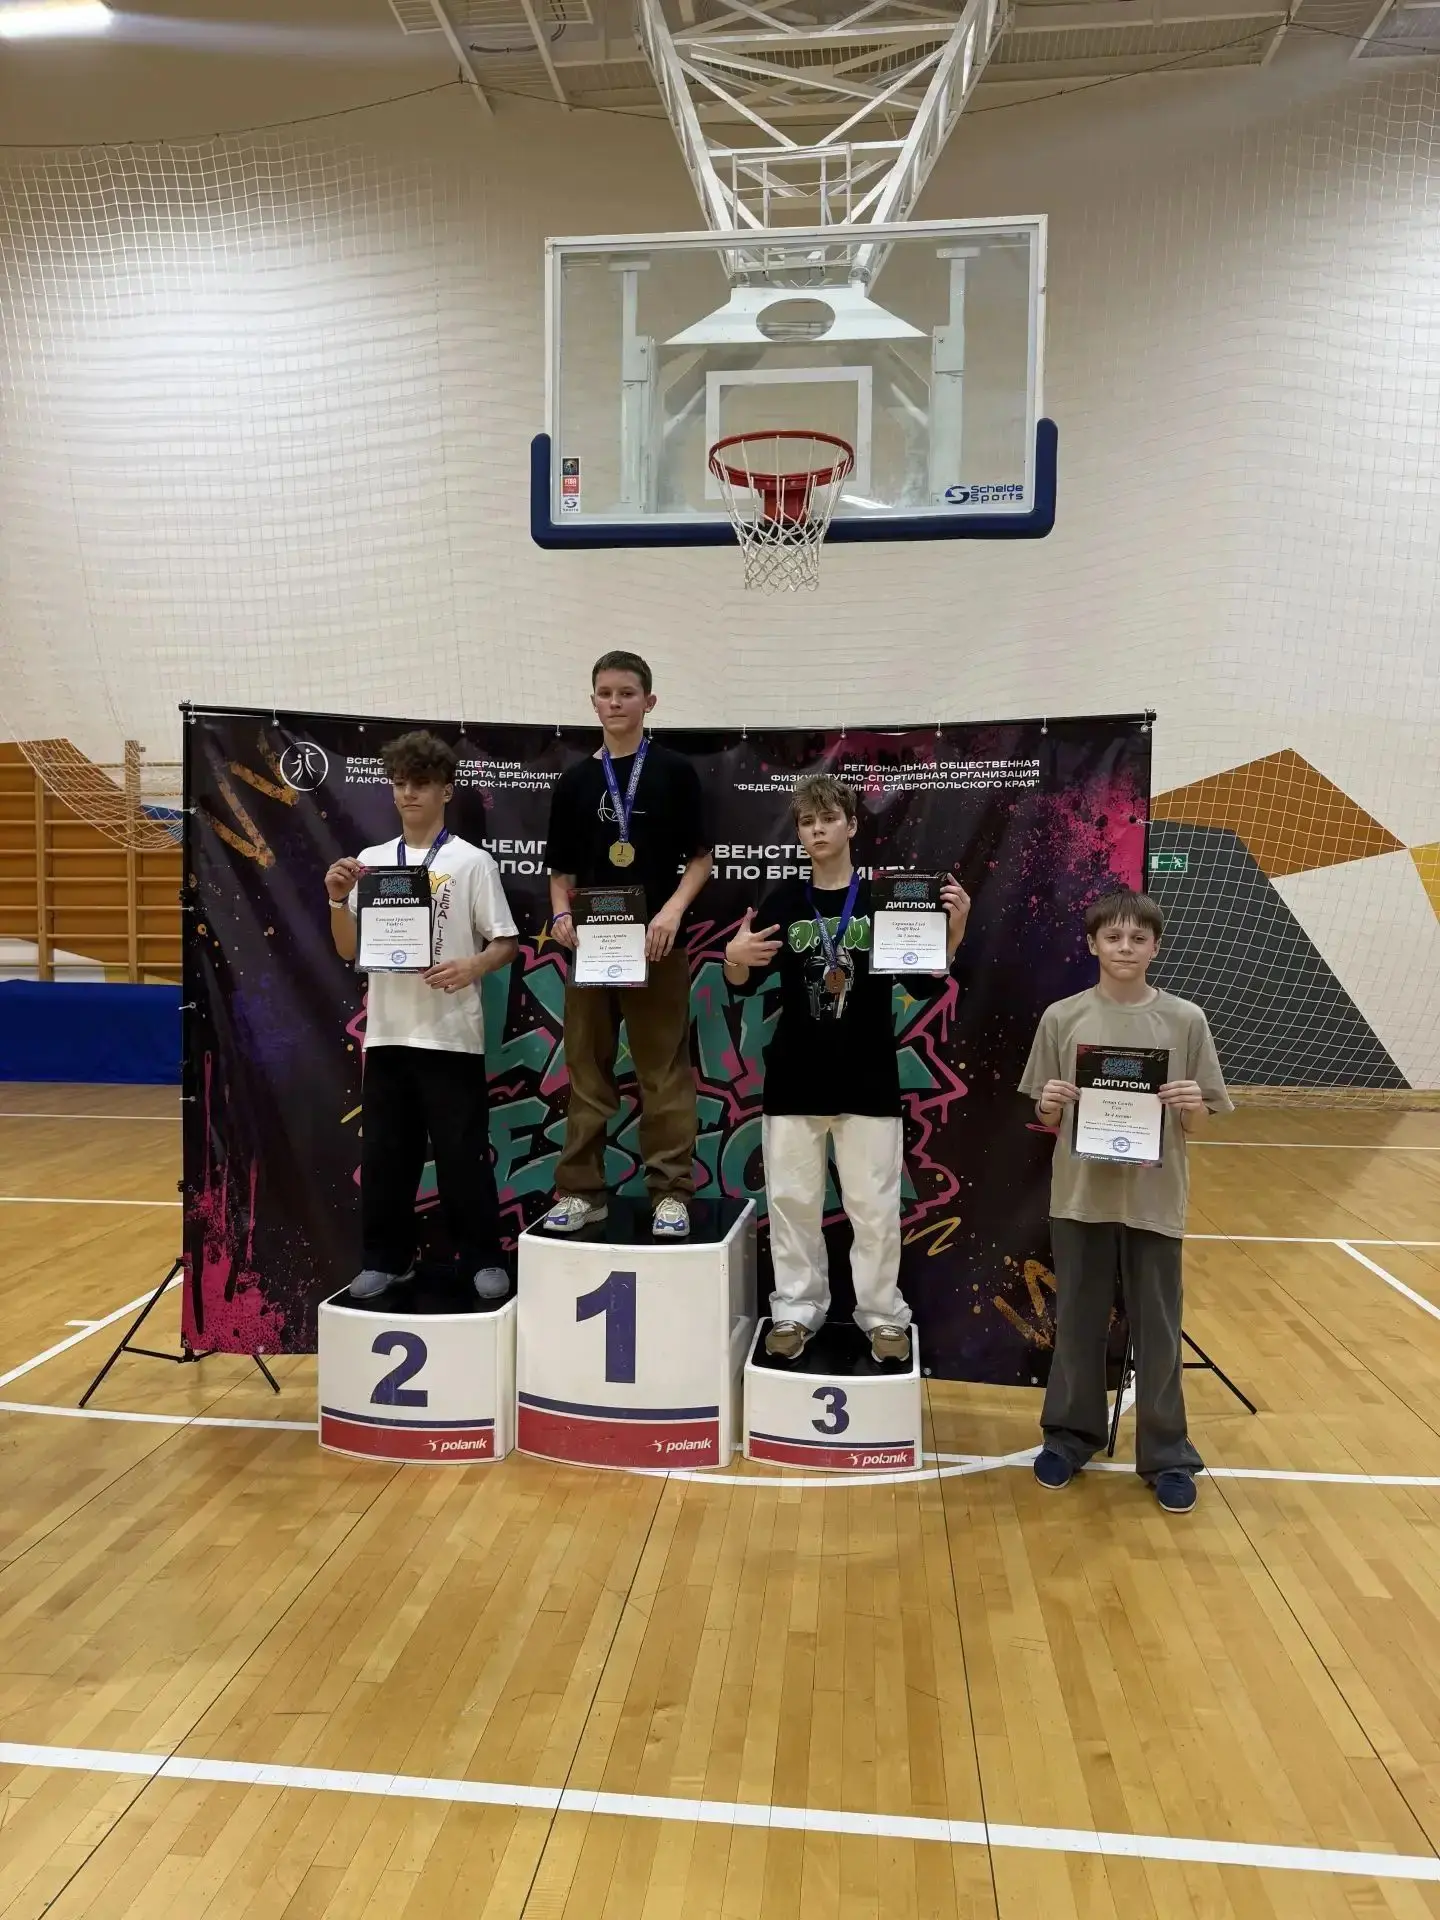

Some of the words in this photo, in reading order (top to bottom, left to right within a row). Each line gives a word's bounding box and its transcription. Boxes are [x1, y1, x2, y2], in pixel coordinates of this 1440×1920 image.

[970, 484, 1024, 494] Schelde
[970, 492, 1024, 504] Sports
[456, 760, 521, 770] ЕДЕРАЦИЯ
[843, 762, 937, 772] РЕГИОНАЛЬНАЯ
[940, 760, 1040, 770] ОБЩЕСТВЕННАЯ
[346, 766, 388, 776] ТАНЦЕ
[455, 770, 497, 779] ПОРТА,
[950, 769, 1040, 779] ОРГАНИЗАЦИЯ
[471, 779, 551, 789] РОК-Н-РОЛЛА
[733, 783, 797, 793] "ФЕДЕРАЦ
[883, 780, 1002, 792] СТАВРОПОЛЬСКОГО
[1004, 779, 1040, 788] КРАЯ"
[725, 865, 761, 880] ПО
[372, 897, 420, 907] ДИПЛОМ
[885, 901, 936, 910] ДИПЛОМ
[586, 914, 635, 924] ДИПЛОМ
[1092, 1078, 1151, 1090] ДИПЛОМ
[576, 1271, 636, 1383] 1
[370, 1331, 428, 1407] 2
[811, 1386, 850, 1435] 3
[440, 1438, 488, 1453] polanik
[666, 1438, 713, 1454] polanik
[861, 1452, 908, 1466] polanik
